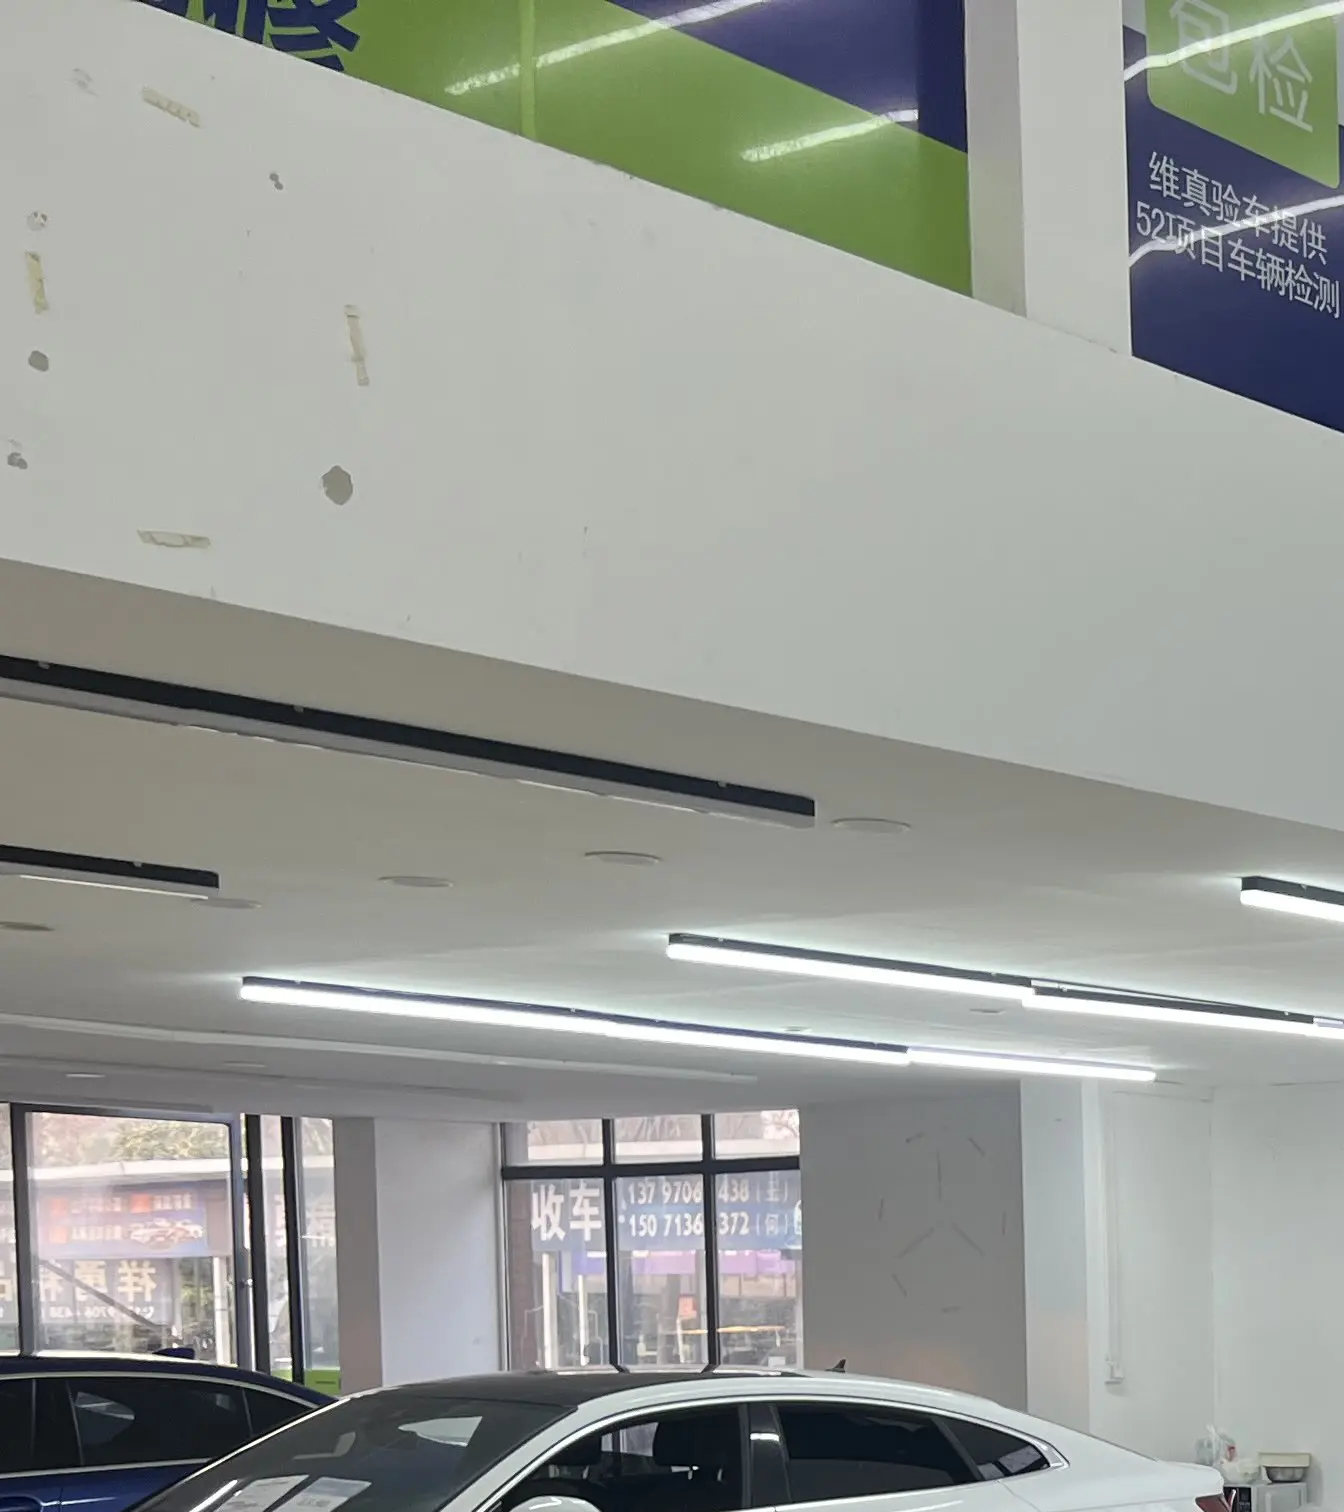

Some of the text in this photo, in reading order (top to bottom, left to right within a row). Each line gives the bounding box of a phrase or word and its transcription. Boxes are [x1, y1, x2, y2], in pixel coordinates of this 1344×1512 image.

[1169, 0, 1314, 134] 包检
[1136, 200, 1341, 319] 52项目车辆检测
[1149, 151, 1328, 266] 维真验车提供
